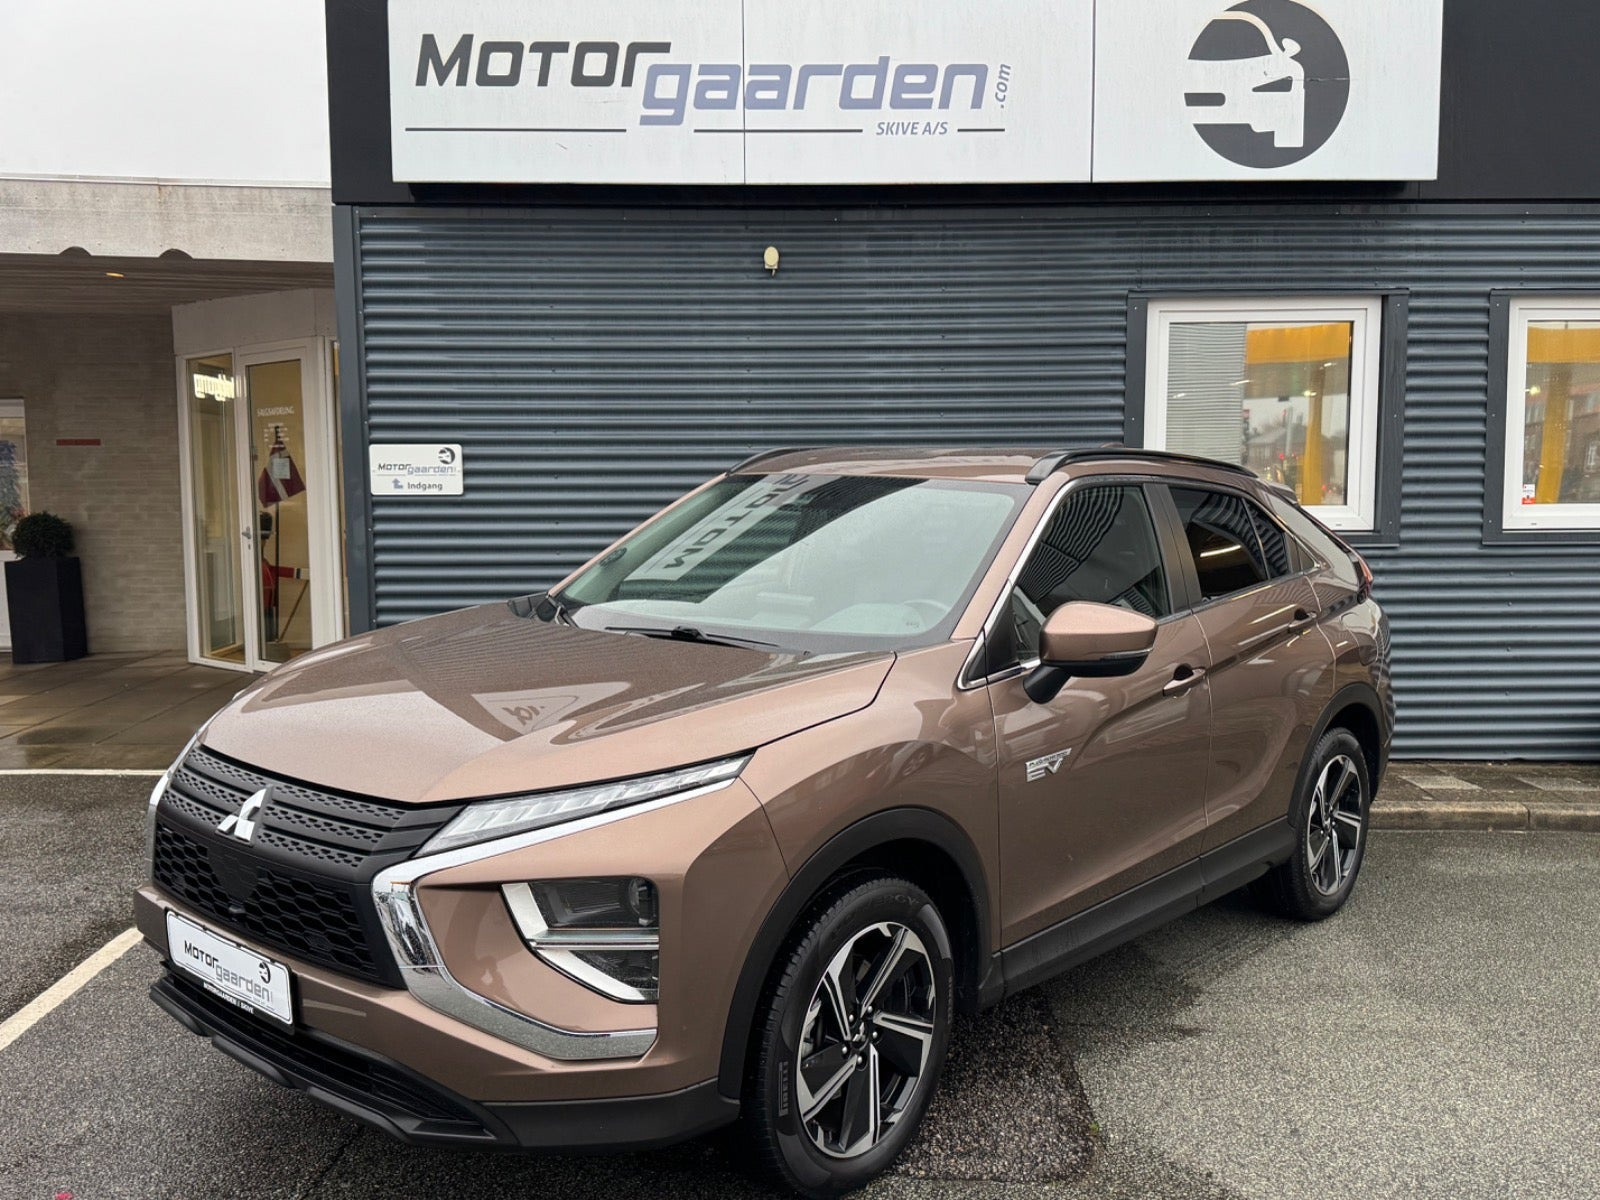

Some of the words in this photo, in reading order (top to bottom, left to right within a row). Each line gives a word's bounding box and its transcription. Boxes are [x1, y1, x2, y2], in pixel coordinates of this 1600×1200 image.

[639, 56, 988, 126] gaarden
[995, 63, 1012, 109] .com
[876, 121, 918, 136] SKIVE
[922, 121, 949, 136] A/S
[407, 465, 453, 475] gaarden
[407, 482, 443, 491] Indgang
[215, 964, 270, 1002] gaarden
